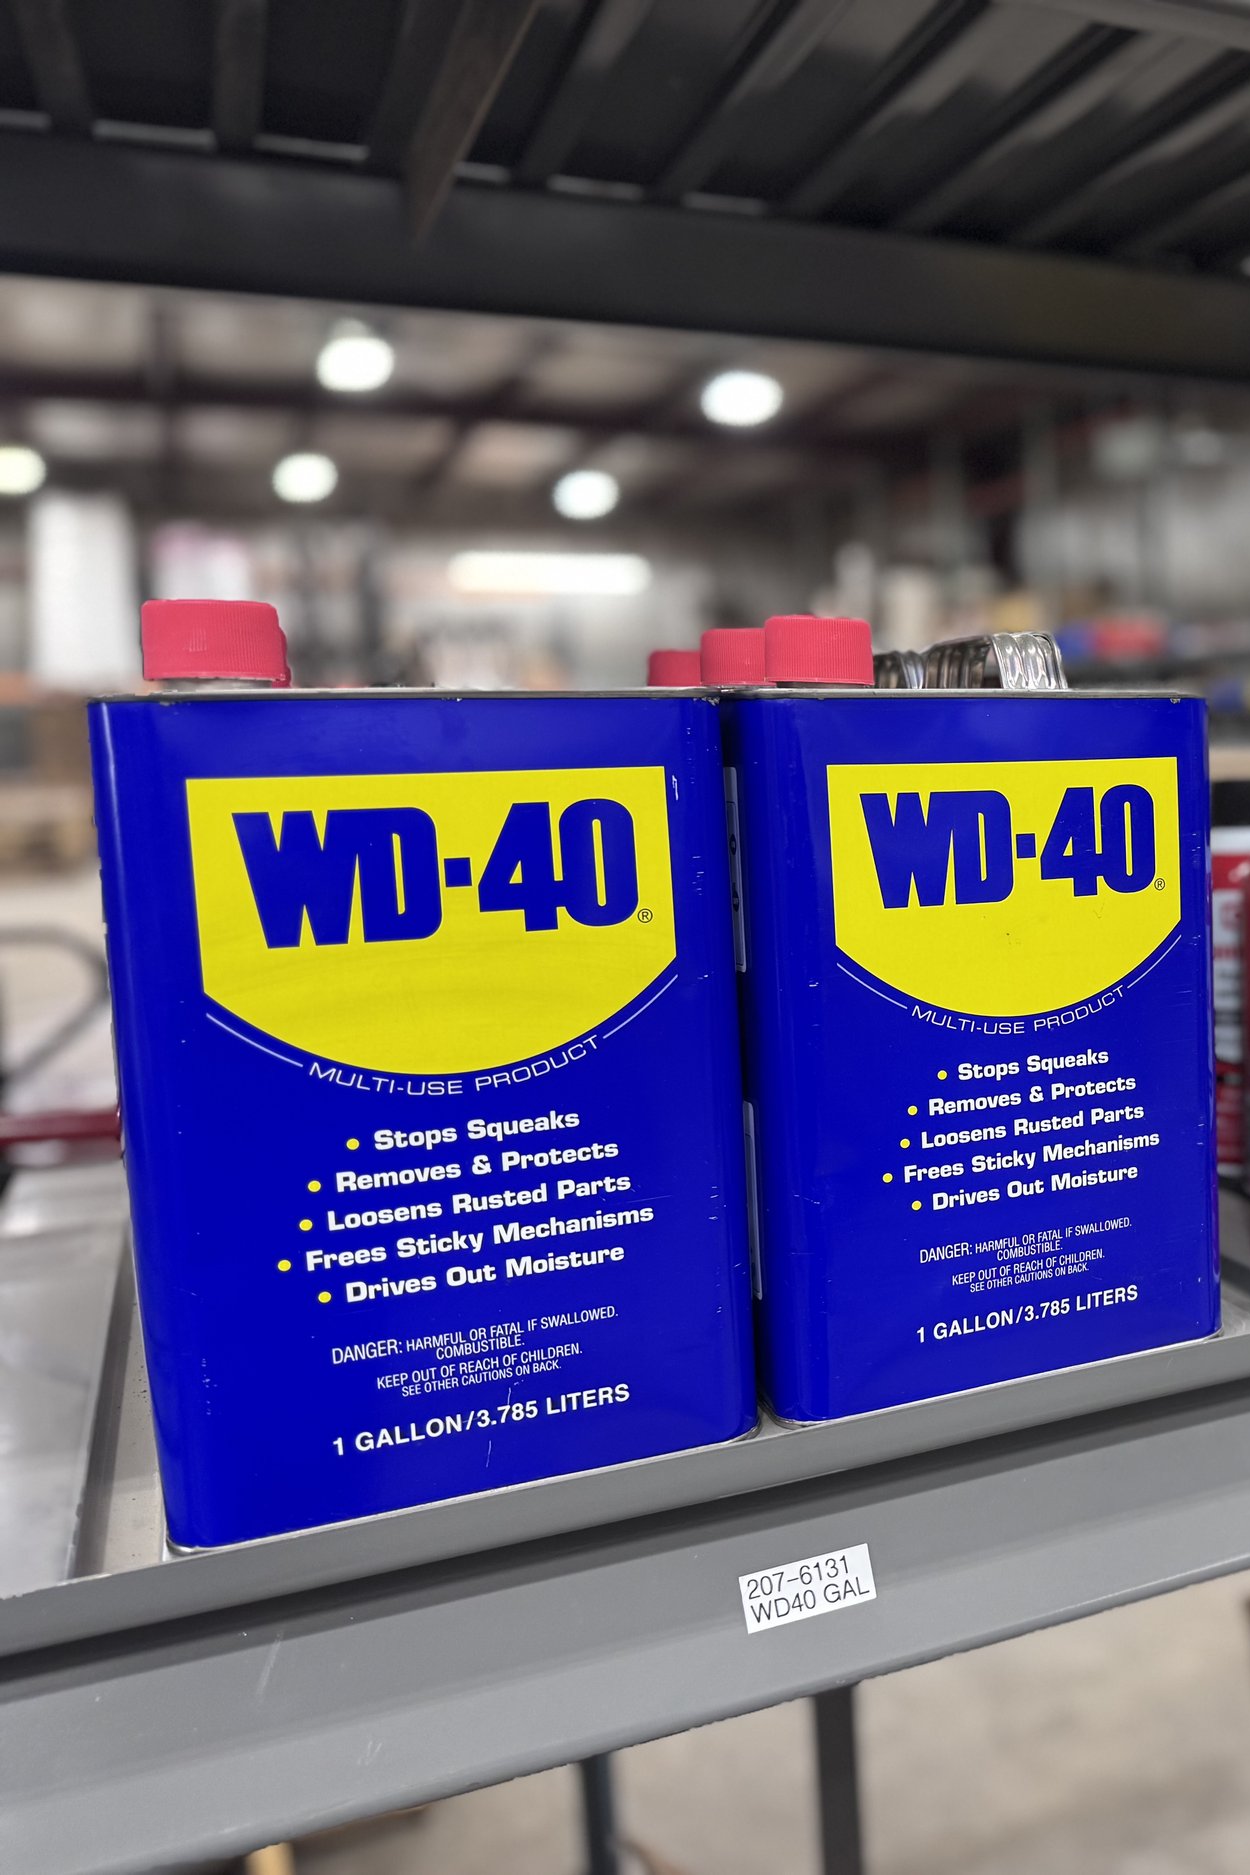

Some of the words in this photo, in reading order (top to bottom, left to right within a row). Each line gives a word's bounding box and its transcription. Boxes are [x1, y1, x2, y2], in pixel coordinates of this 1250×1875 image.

[859, 784, 1156, 909] WD-40
[231, 798, 639, 949] WD-40
[912, 1005, 1024, 1034] MULTI-USE
[1034, 985, 1124, 1031] PRODUCT
[309, 1062, 463, 1095] MULTI-USE
[475, 1034, 598, 1091] PRODUCT
[958, 1062, 1020, 1081] Stops
[1027, 1049, 1108, 1074] Squeaks
[929, 1093, 1022, 1116] Removes
[1029, 1086, 1044, 1102] &
[1051, 1078, 1136, 1100] Protects
[374, 1128, 457, 1150] Stops
[467, 1110, 580, 1142] Squeaks
[922, 1126, 1006, 1148] Loosens
[1014, 1110, 1084, 1136] Rusted
[1091, 1106, 1144, 1125] Parts
[336, 1164, 461, 1192] Removes
[472, 1155, 492, 1175] &
[502, 1143, 618, 1172] Protects
[904, 1163, 964, 1183] Frees
[972, 1150, 1036, 1172] Sticky
[1043, 1134, 1160, 1162] Mechanisms
[328, 1202, 442, 1231] Loosens
[452, 1183, 547, 1214] Rusted
[557, 1176, 631, 1200] Parts
[932, 1188, 1000, 1210] Drives
[1007, 1180, 1044, 1198] Out
[1051, 1167, 1138, 1191] Moisture
[306, 1247, 387, 1271] Frees
[396, 1231, 484, 1258] Sticky
[493, 1208, 654, 1244] Mechanisms
[920, 1242, 972, 1263] DANGER:
[975, 1236, 1020, 1254] HARMFUL
[1022, 1234, 1035, 1245] OR
[1038, 1229, 1063, 1242] FATAL
[1066, 1227, 1073, 1238] IF
[1075, 1217, 1132, 1236] SWALLOWED.
[997, 1240, 1063, 1261] COMBUSTIBLE.
[346, 1276, 437, 1302] Drives
[446, 1265, 496, 1286] Out
[506, 1247, 624, 1278] Moisture
[952, 1272, 976, 1286] KEEP
[978, 1267, 997, 1280] OUT
[1000, 1265, 1011, 1276] OF
[1014, 1259, 1043, 1274] REACH
[1046, 1256, 1057, 1268] OF
[1059, 1248, 1104, 1266] CHILDREN.
[970, 1281, 984, 1292] SEE
[987, 1276, 1012, 1289] OTHER
[1014, 1268, 1053, 1284] CAUTIONS
[1055, 1266, 1066, 1276] ON
[332, 1339, 402, 1364] DANGER:
[406, 1332, 466, 1352] HARMFUL
[470, 1328, 486, 1341] OR
[490, 1322, 524, 1338] FATAL
[528, 1318, 537, 1331] IF
[540, 1306, 618, 1329] SWALLOWED.
[917, 1327, 924, 1343] 1
[1076, 1284, 1138, 1311] LITERS
[377, 1373, 408, 1389] KEEP
[412, 1367, 437, 1383] OUT
[440, 1364, 455, 1378] OF
[459, 1356, 499, 1374] REACH
[502, 1353, 517, 1366] OF
[521, 1343, 582, 1363] CHILDREN.
[436, 1335, 524, 1360] COMBUSTIBLE.
[402, 1384, 421, 1397] SEE
[424, 1377, 459, 1392] OTHER
[462, 1367, 513, 1386] CAUTIONS
[516, 1364, 530, 1376] ON
[533, 1359, 561, 1373] BACK.
[333, 1437, 344, 1456] 1
[546, 1384, 630, 1414] LITERS
[747, 1555, 849, 1600] 207-6131
[750, 1589, 816, 1623] WD40
[823, 1576, 870, 1603] GAL
